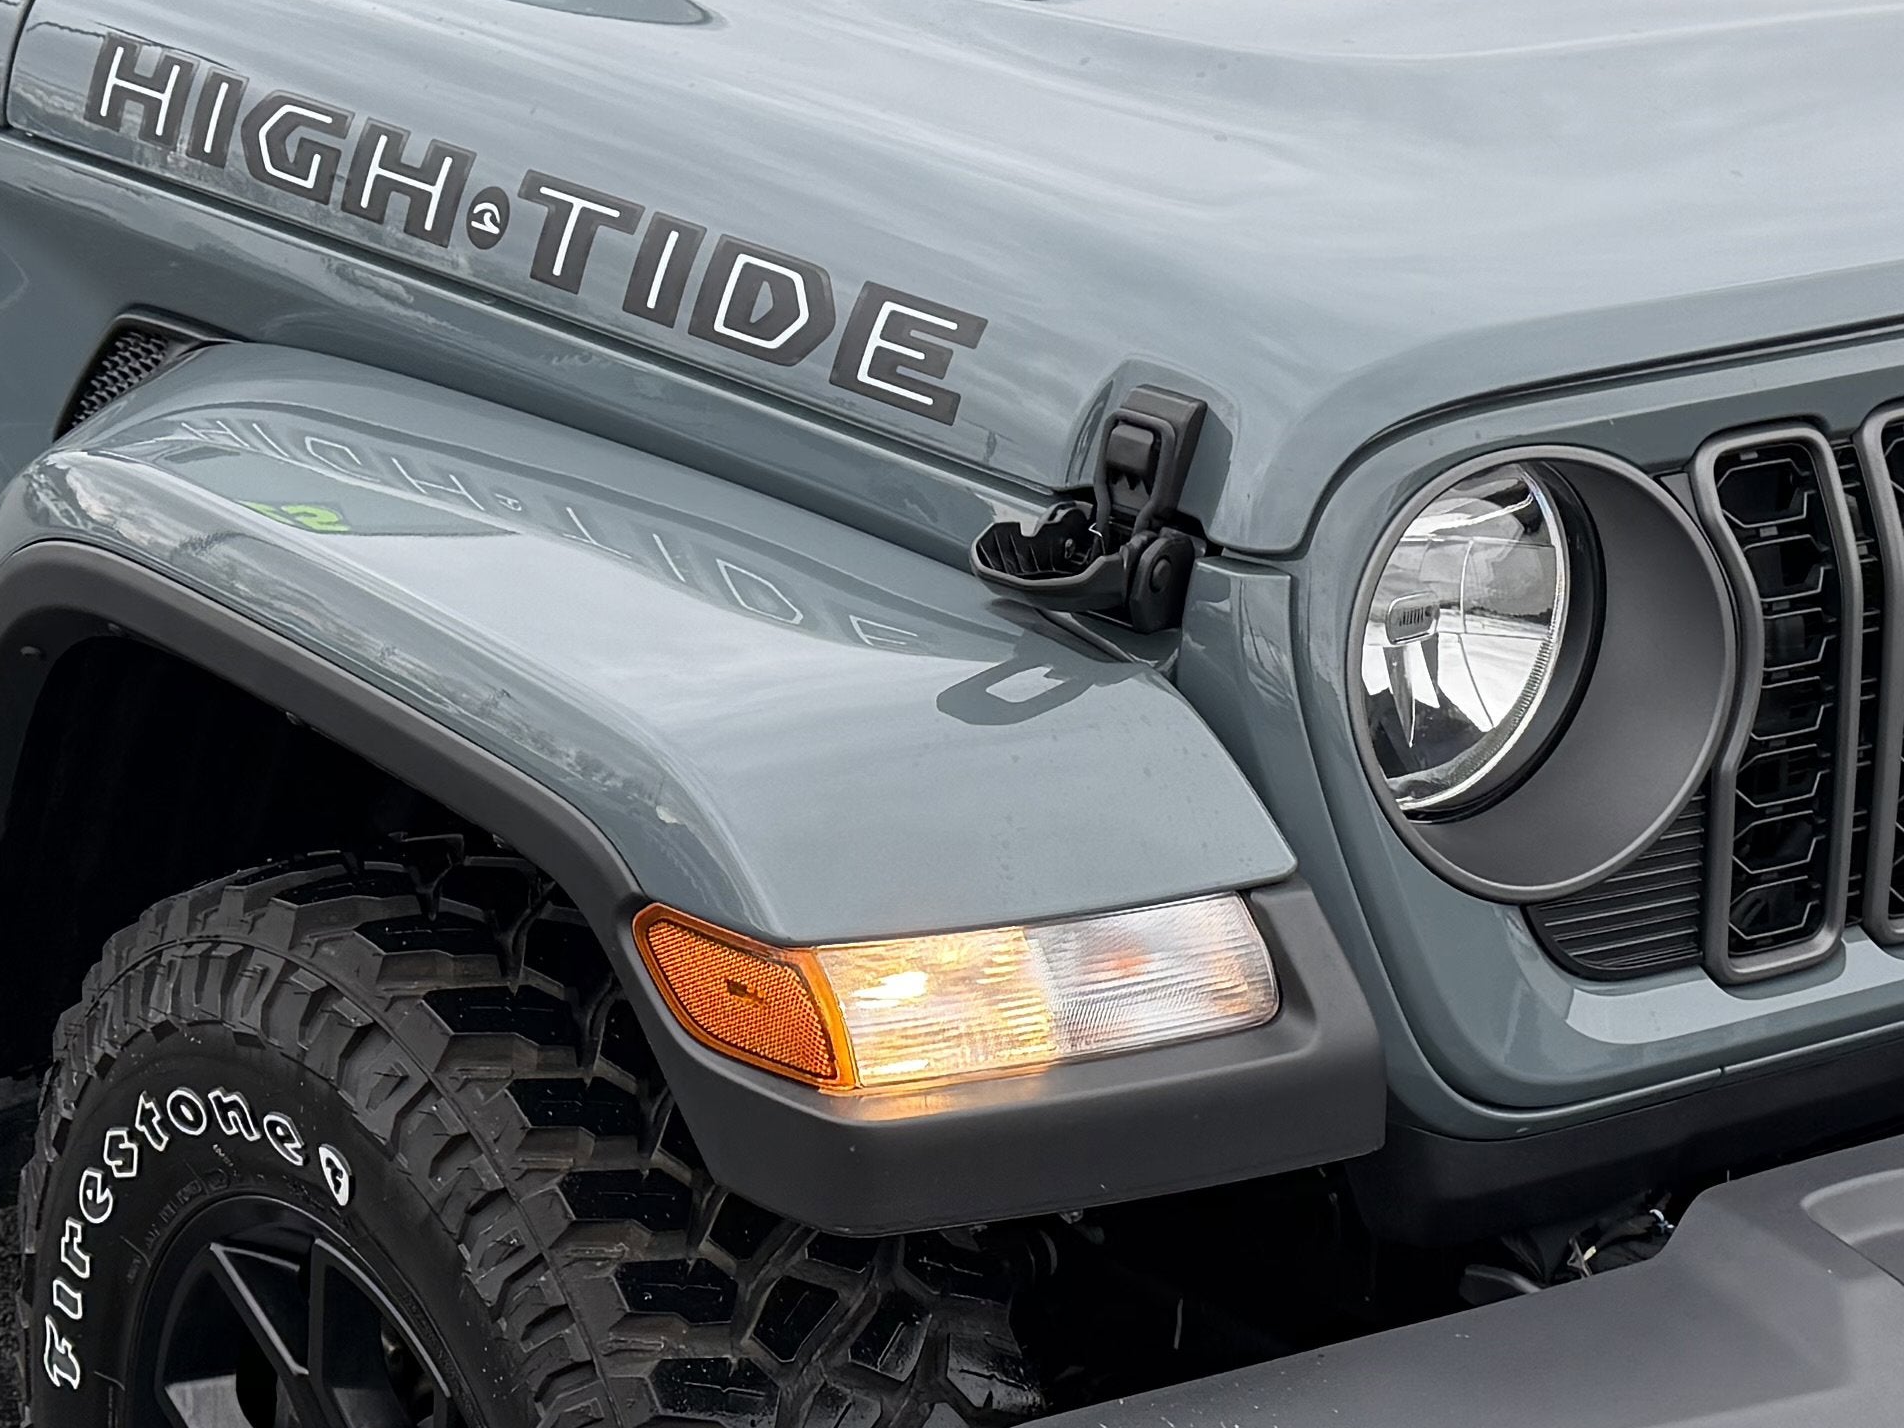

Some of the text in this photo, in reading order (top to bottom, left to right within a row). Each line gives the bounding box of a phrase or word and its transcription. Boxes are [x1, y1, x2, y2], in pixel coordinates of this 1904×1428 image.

[84, 32, 987, 425] HIGH TIDE
[43, 1087, 305, 1390] Firestone
